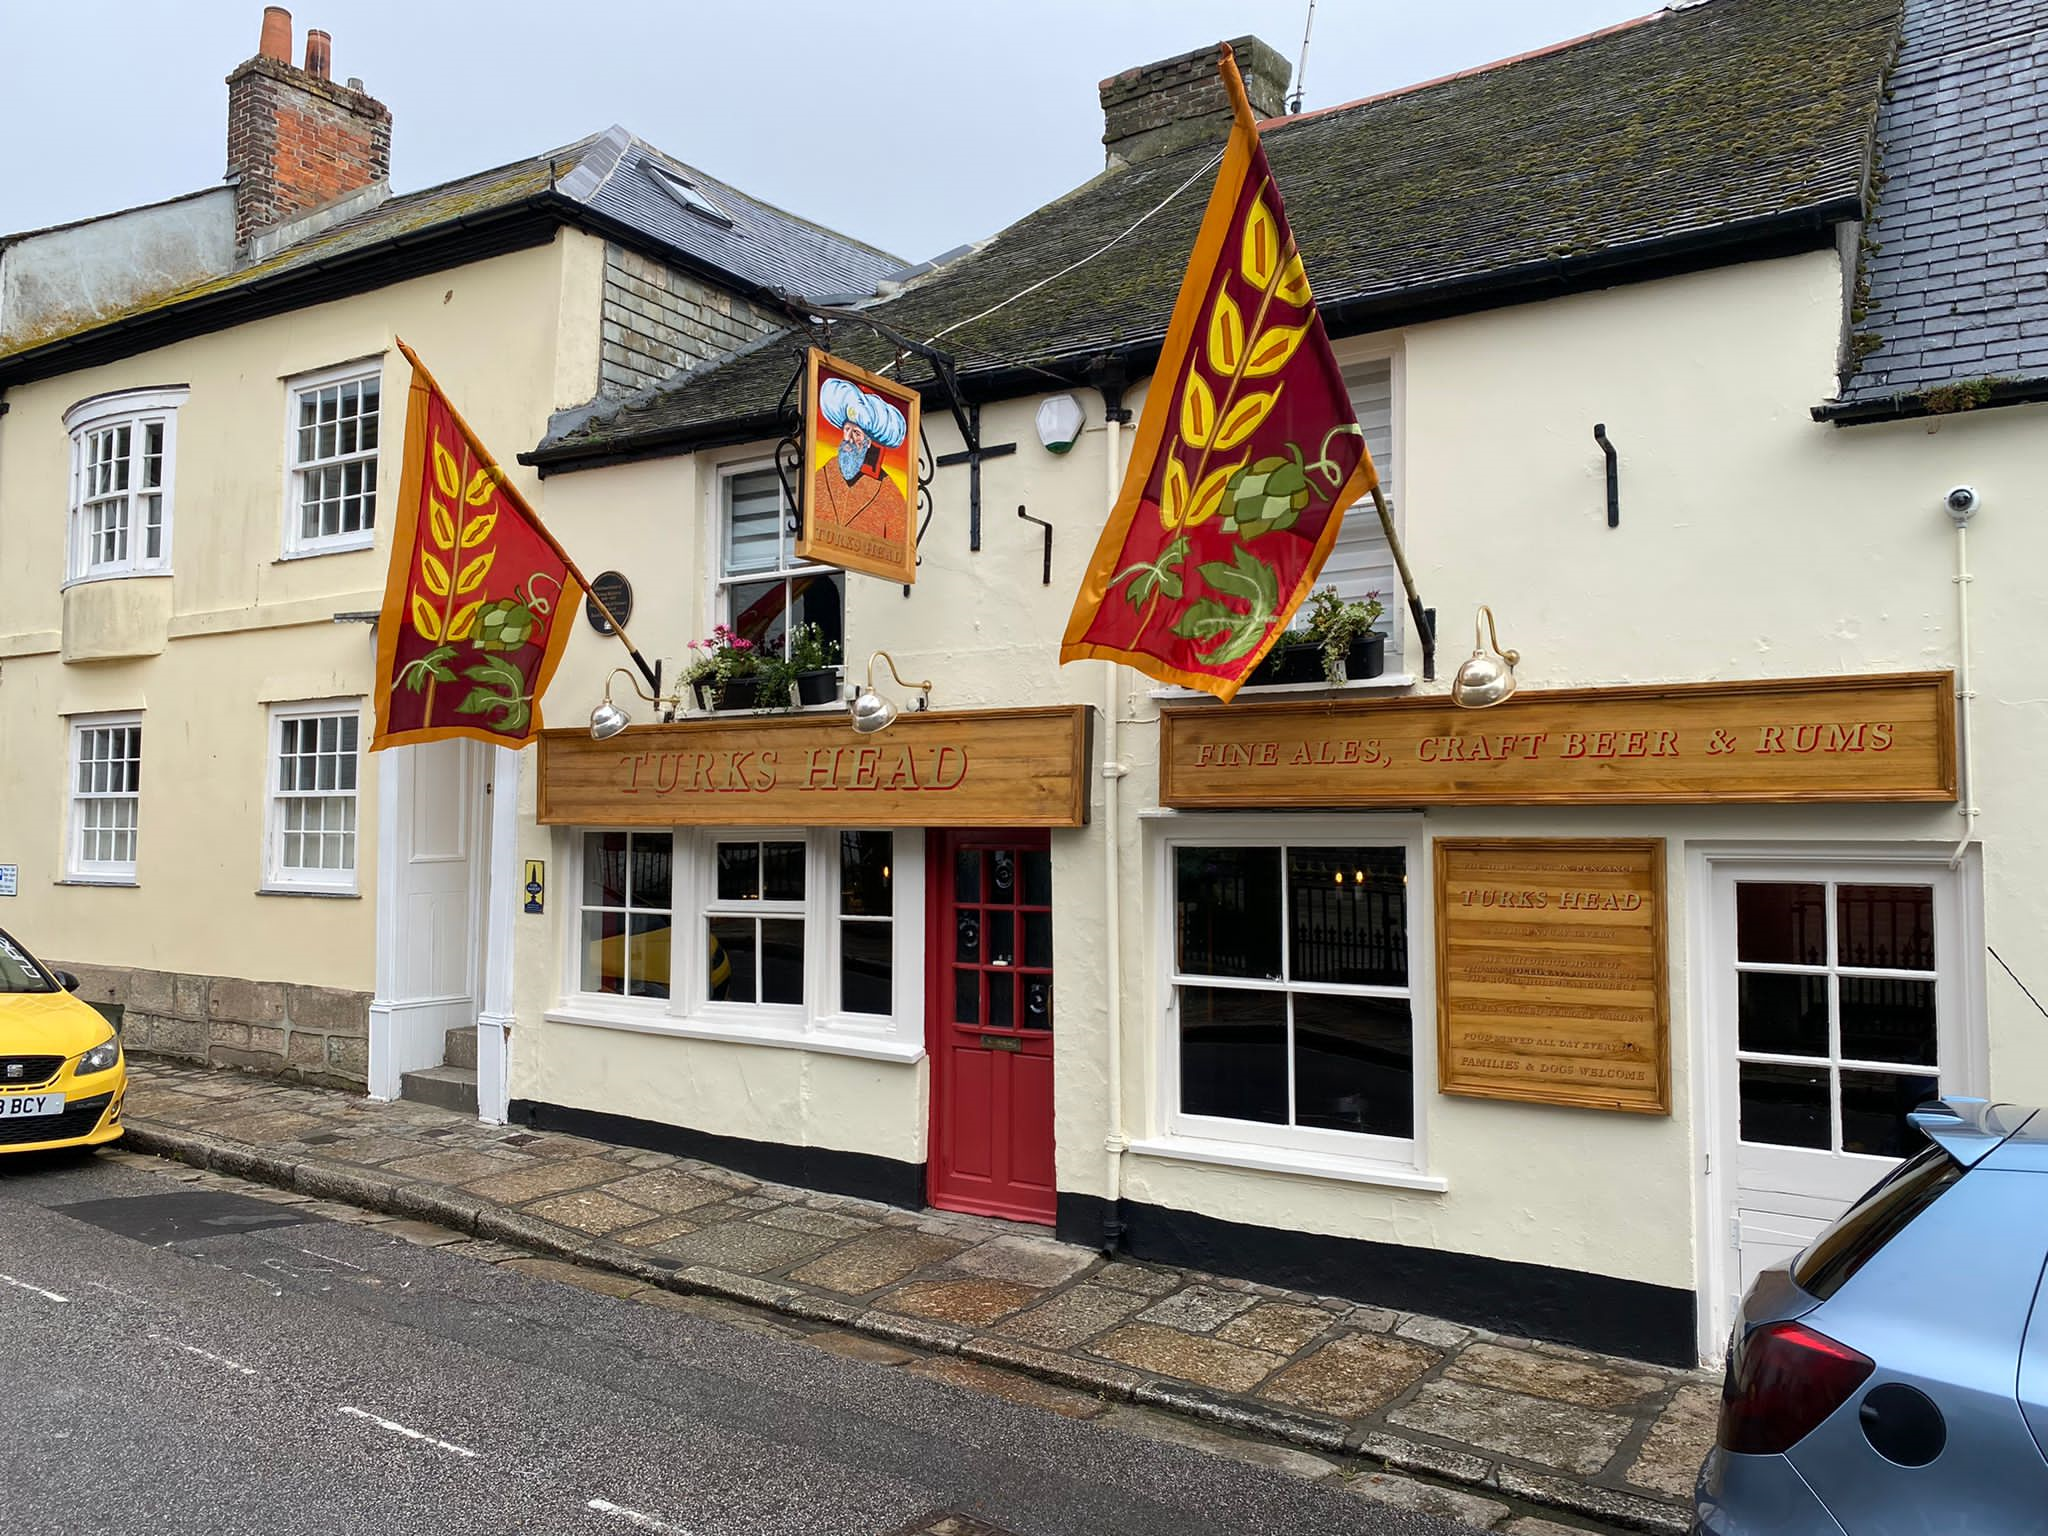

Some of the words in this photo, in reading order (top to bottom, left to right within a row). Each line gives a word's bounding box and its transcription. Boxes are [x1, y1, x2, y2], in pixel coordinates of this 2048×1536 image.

[1195, 742, 1280, 767] FINE
[1290, 738, 1392, 768] ALES,
[1416, 733, 1548, 762] CRAFT
[1559, 728, 1680, 758] BEER
[1705, 727, 1737, 755] &
[1755, 722, 1894, 753] RUMS
[620, 751, 781, 794] TURKS
[799, 744, 969, 791] HEAD
[1460, 888, 1549, 909] TURKS
[1558, 891, 1643, 912] HEAD
[1560, 1040, 1580, 1048] DAY
[1460, 1057, 1520, 1070] FAMILIES
[1526, 1063, 1536, 1072] &
[1540, 1064, 1575, 1075] DOGS
[1580, 1067, 1646, 1081] WELCOME
[10, 1096, 46, 1114] BCY
